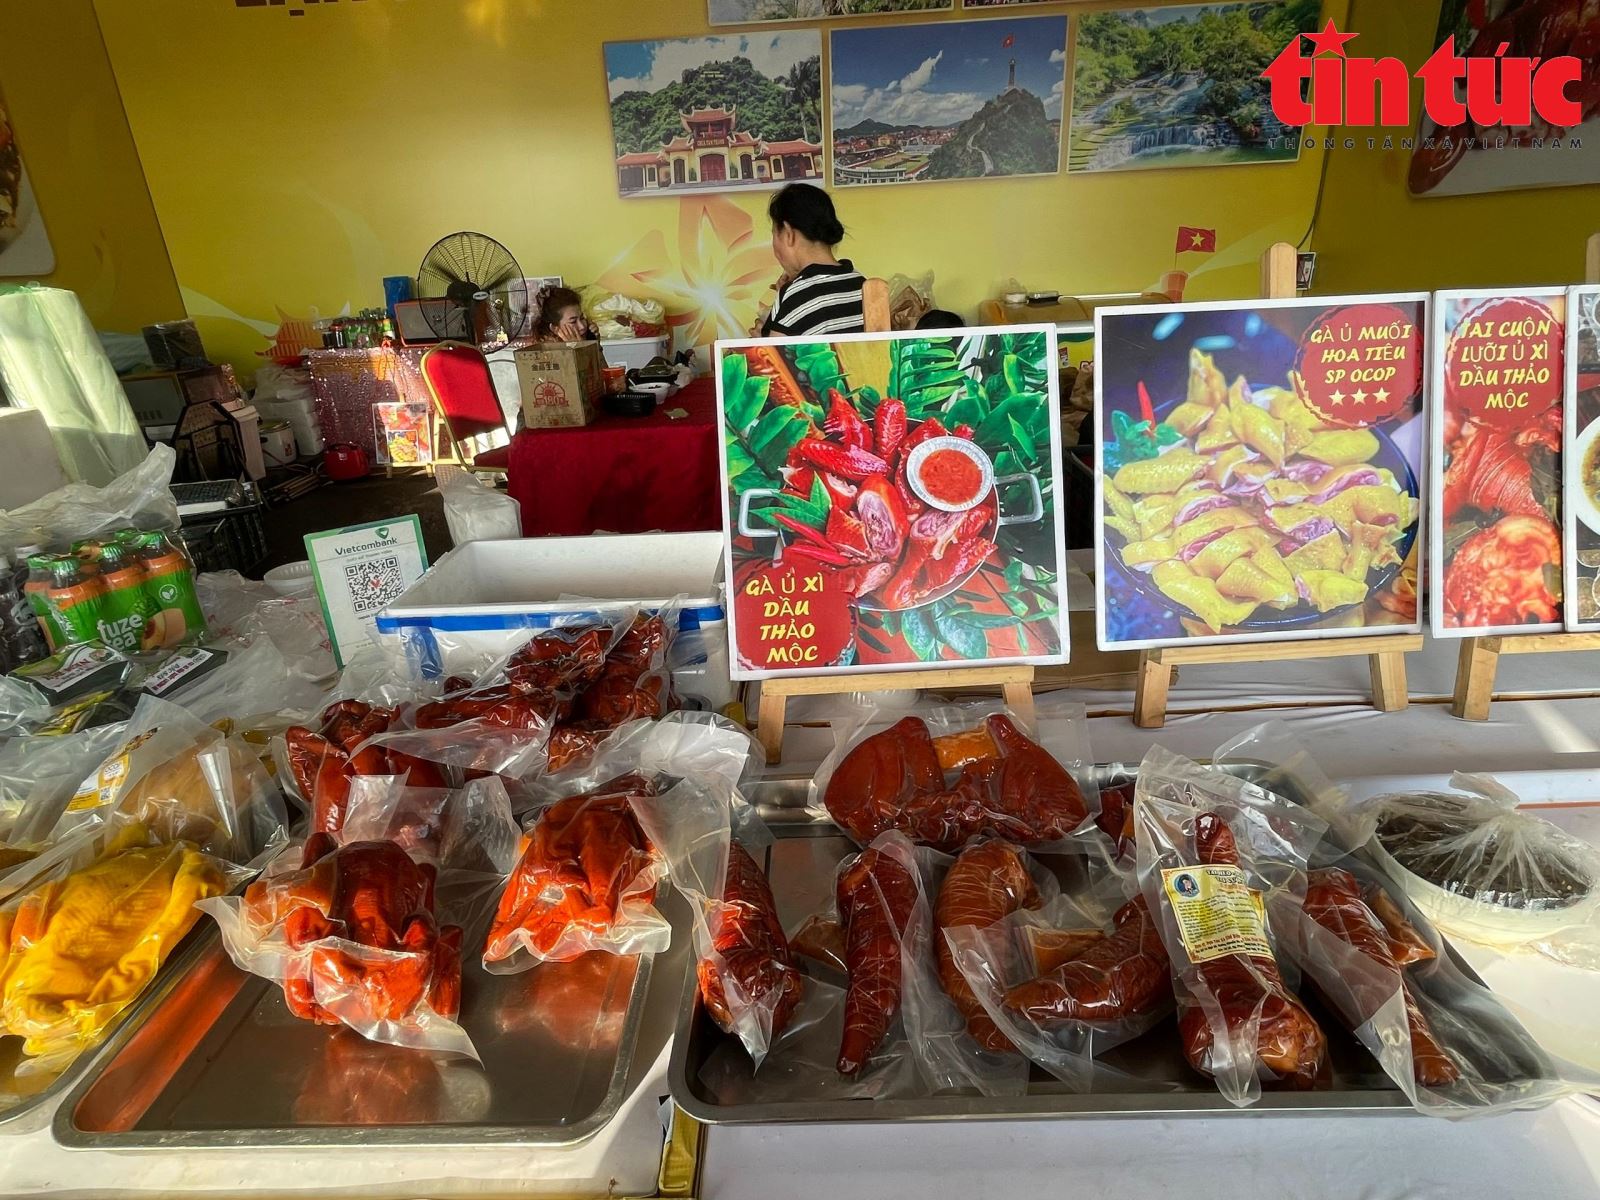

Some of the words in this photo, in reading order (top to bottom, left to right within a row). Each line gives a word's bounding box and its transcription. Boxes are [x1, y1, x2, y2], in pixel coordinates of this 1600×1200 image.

[1311, 324, 1335, 344] GÀ
[1340, 322, 1352, 342] Ủ
[1358, 319, 1412, 341] MUỐI
[1499, 316, 1550, 340] CUỘN
[1321, 348, 1360, 363] HOA
[1365, 342, 1406, 362] TIÊU
[1461, 341, 1508, 363] LƯỠI
[1512, 339, 1525, 361] Ủ
[1530, 339, 1548, 361] XÌ
[1325, 369, 1346, 384] SP
[1350, 366, 1396, 383] OCOP
[1460, 364, 1499, 387] DẦU
[1503, 362, 1550, 385] THẢO
[1484, 388, 1529, 412] MỘC
[335, 537, 397, 555] Vietcombank
[745, 574, 775, 596] GÀ
[781, 572, 796, 594] Ủ
[802, 572, 824, 593] XÌ
[763, 595, 810, 618] DẦU
[97, 614, 144, 645] fuze
[759, 618, 816, 641] THẢO
[766, 642, 818, 666] MỘC
